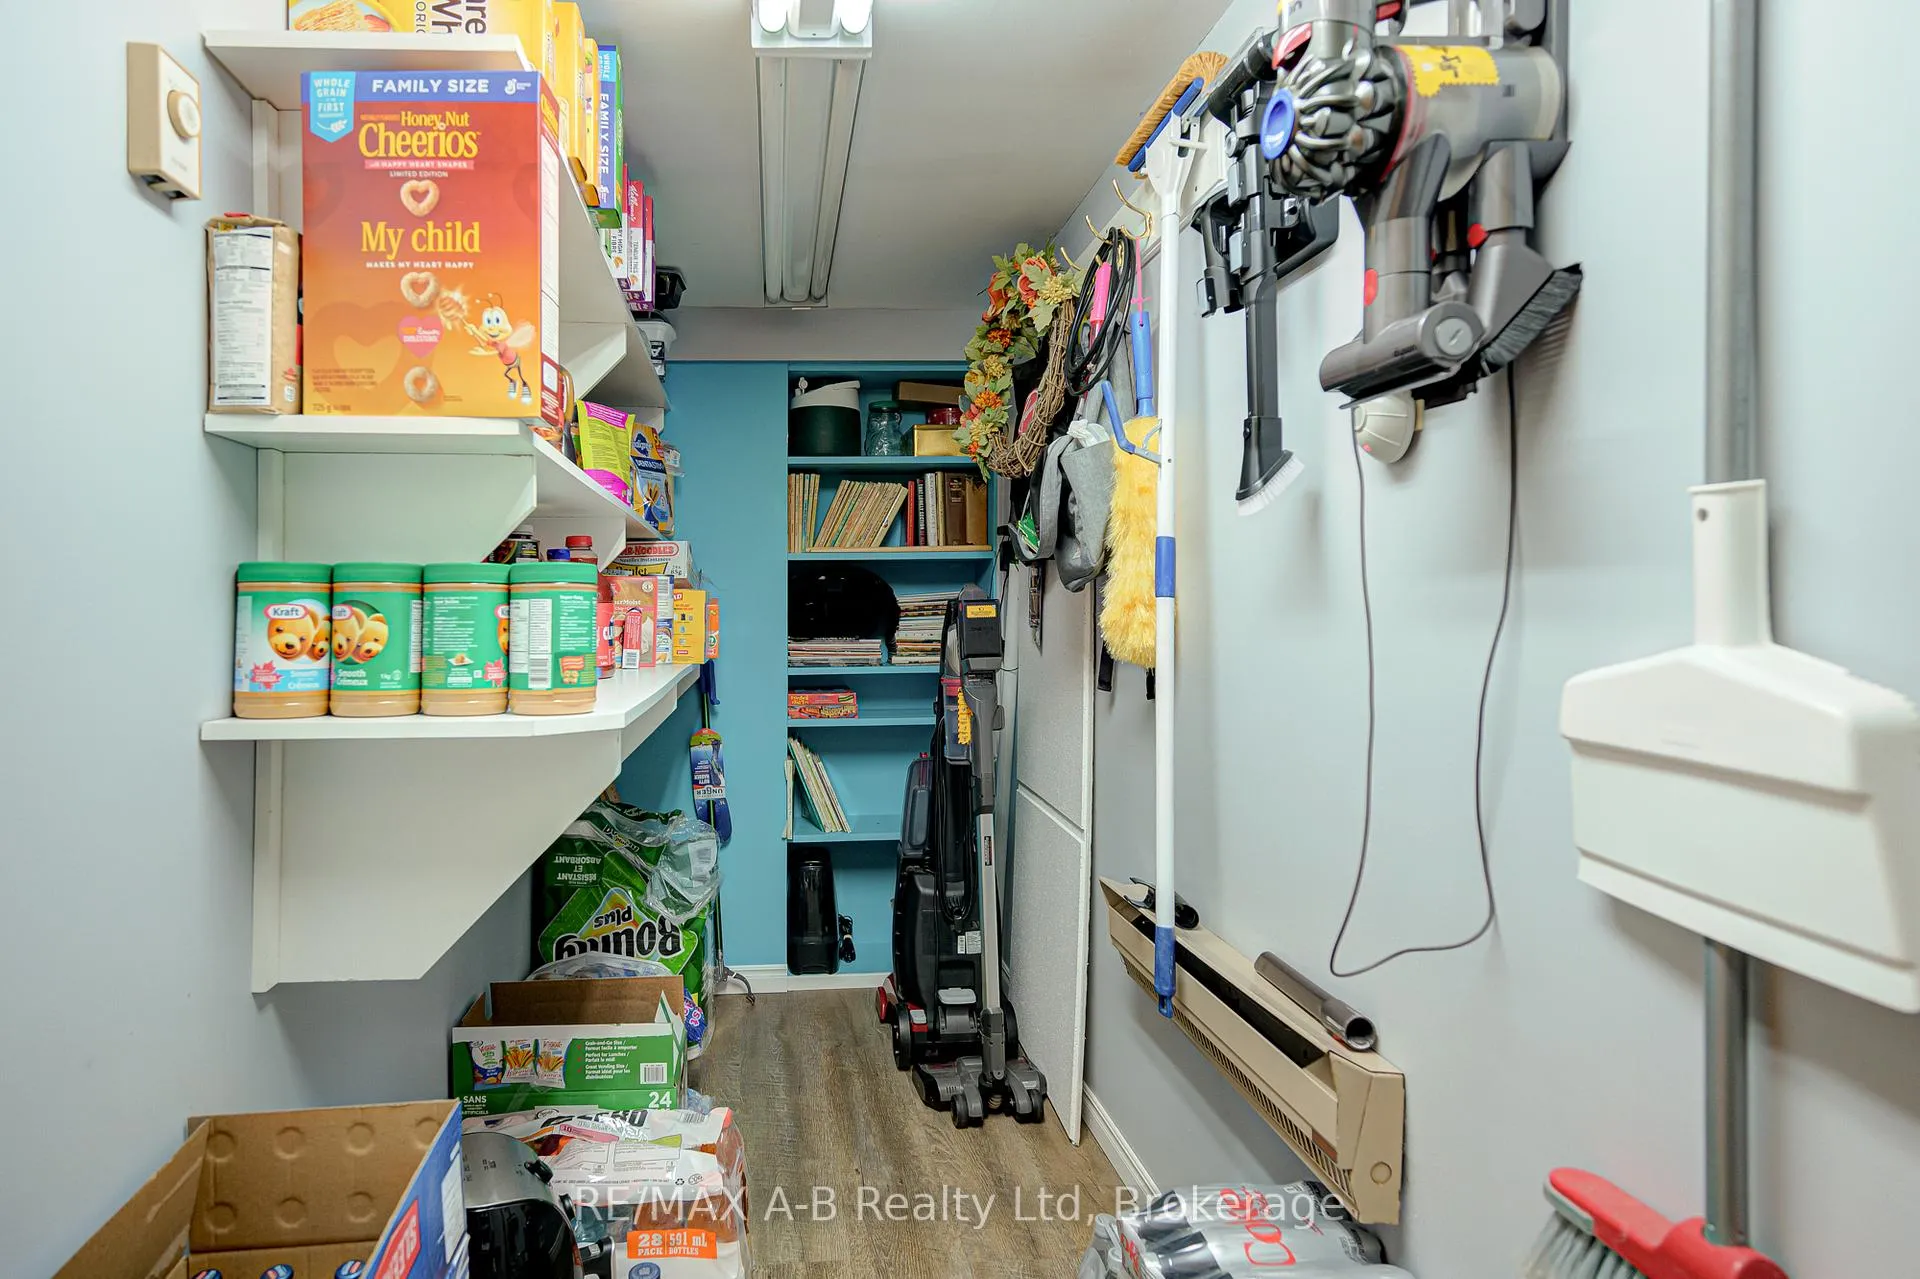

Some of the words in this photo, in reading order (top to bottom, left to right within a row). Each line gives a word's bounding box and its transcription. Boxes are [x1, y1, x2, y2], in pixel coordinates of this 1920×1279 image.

[313, 77, 351, 88] WHOLE
[372, 79, 442, 93] FAMILY
[447, 79, 489, 93] SIZE
[316, 87, 347, 97] GRAIN
[317, 102, 345, 113] FIRST
[400, 111, 442, 130] Honey
[445, 111, 470, 127] Nut
[358, 122, 479, 158] Cheerios
[389, 170, 418, 178] LIMITED
[418, 170, 449, 178] EDITION
[360, 221, 406, 261] My
[411, 220, 481, 253] child
[272, 607, 300, 617] Kraft
[553, 855, 602, 864] ABSORBANT
[556, 871, 598, 882] RÉSISTANT
[463, 1095, 488, 1104] SANS
[648, 1091, 673, 1108] 24
[638, 1233, 663, 1247] 28
[669, 1232, 688, 1246] 591
[692, 1232, 708, 1247] mL
[637, 1247, 663, 1256] PACK
[669, 1247, 699, 1256] BOTTLES
